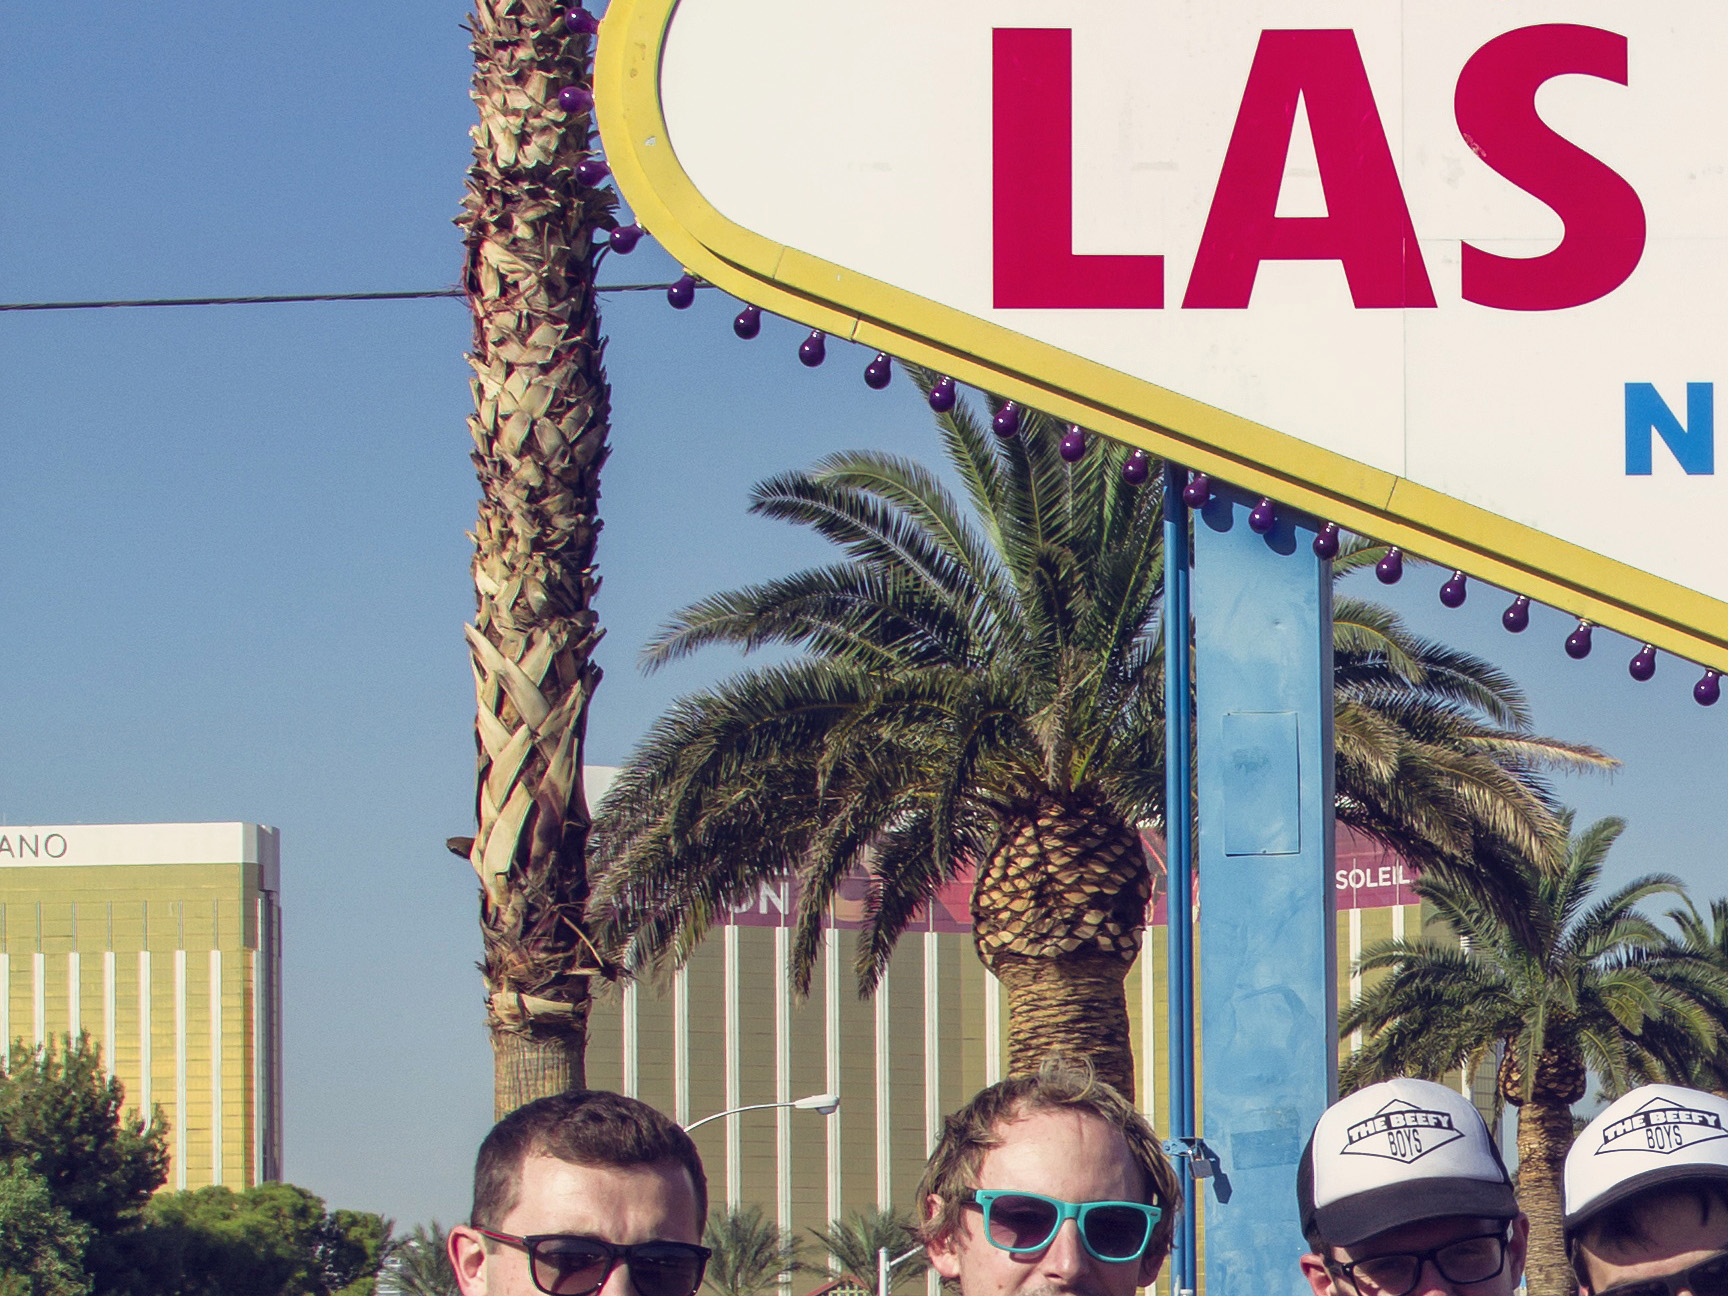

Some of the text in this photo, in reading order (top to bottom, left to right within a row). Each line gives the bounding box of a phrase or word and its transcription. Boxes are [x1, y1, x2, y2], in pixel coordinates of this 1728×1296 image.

[992, 23, 1647, 311] LAS
[1335, 865, 1411, 890] SOLEIL
[1349, 1112, 1451, 1142] THE BEEFY
[1604, 1110, 1718, 1142] THE BEEFY
[1646, 1124, 1683, 1150] BOYS
[1387, 1128, 1423, 1158] BOYS
